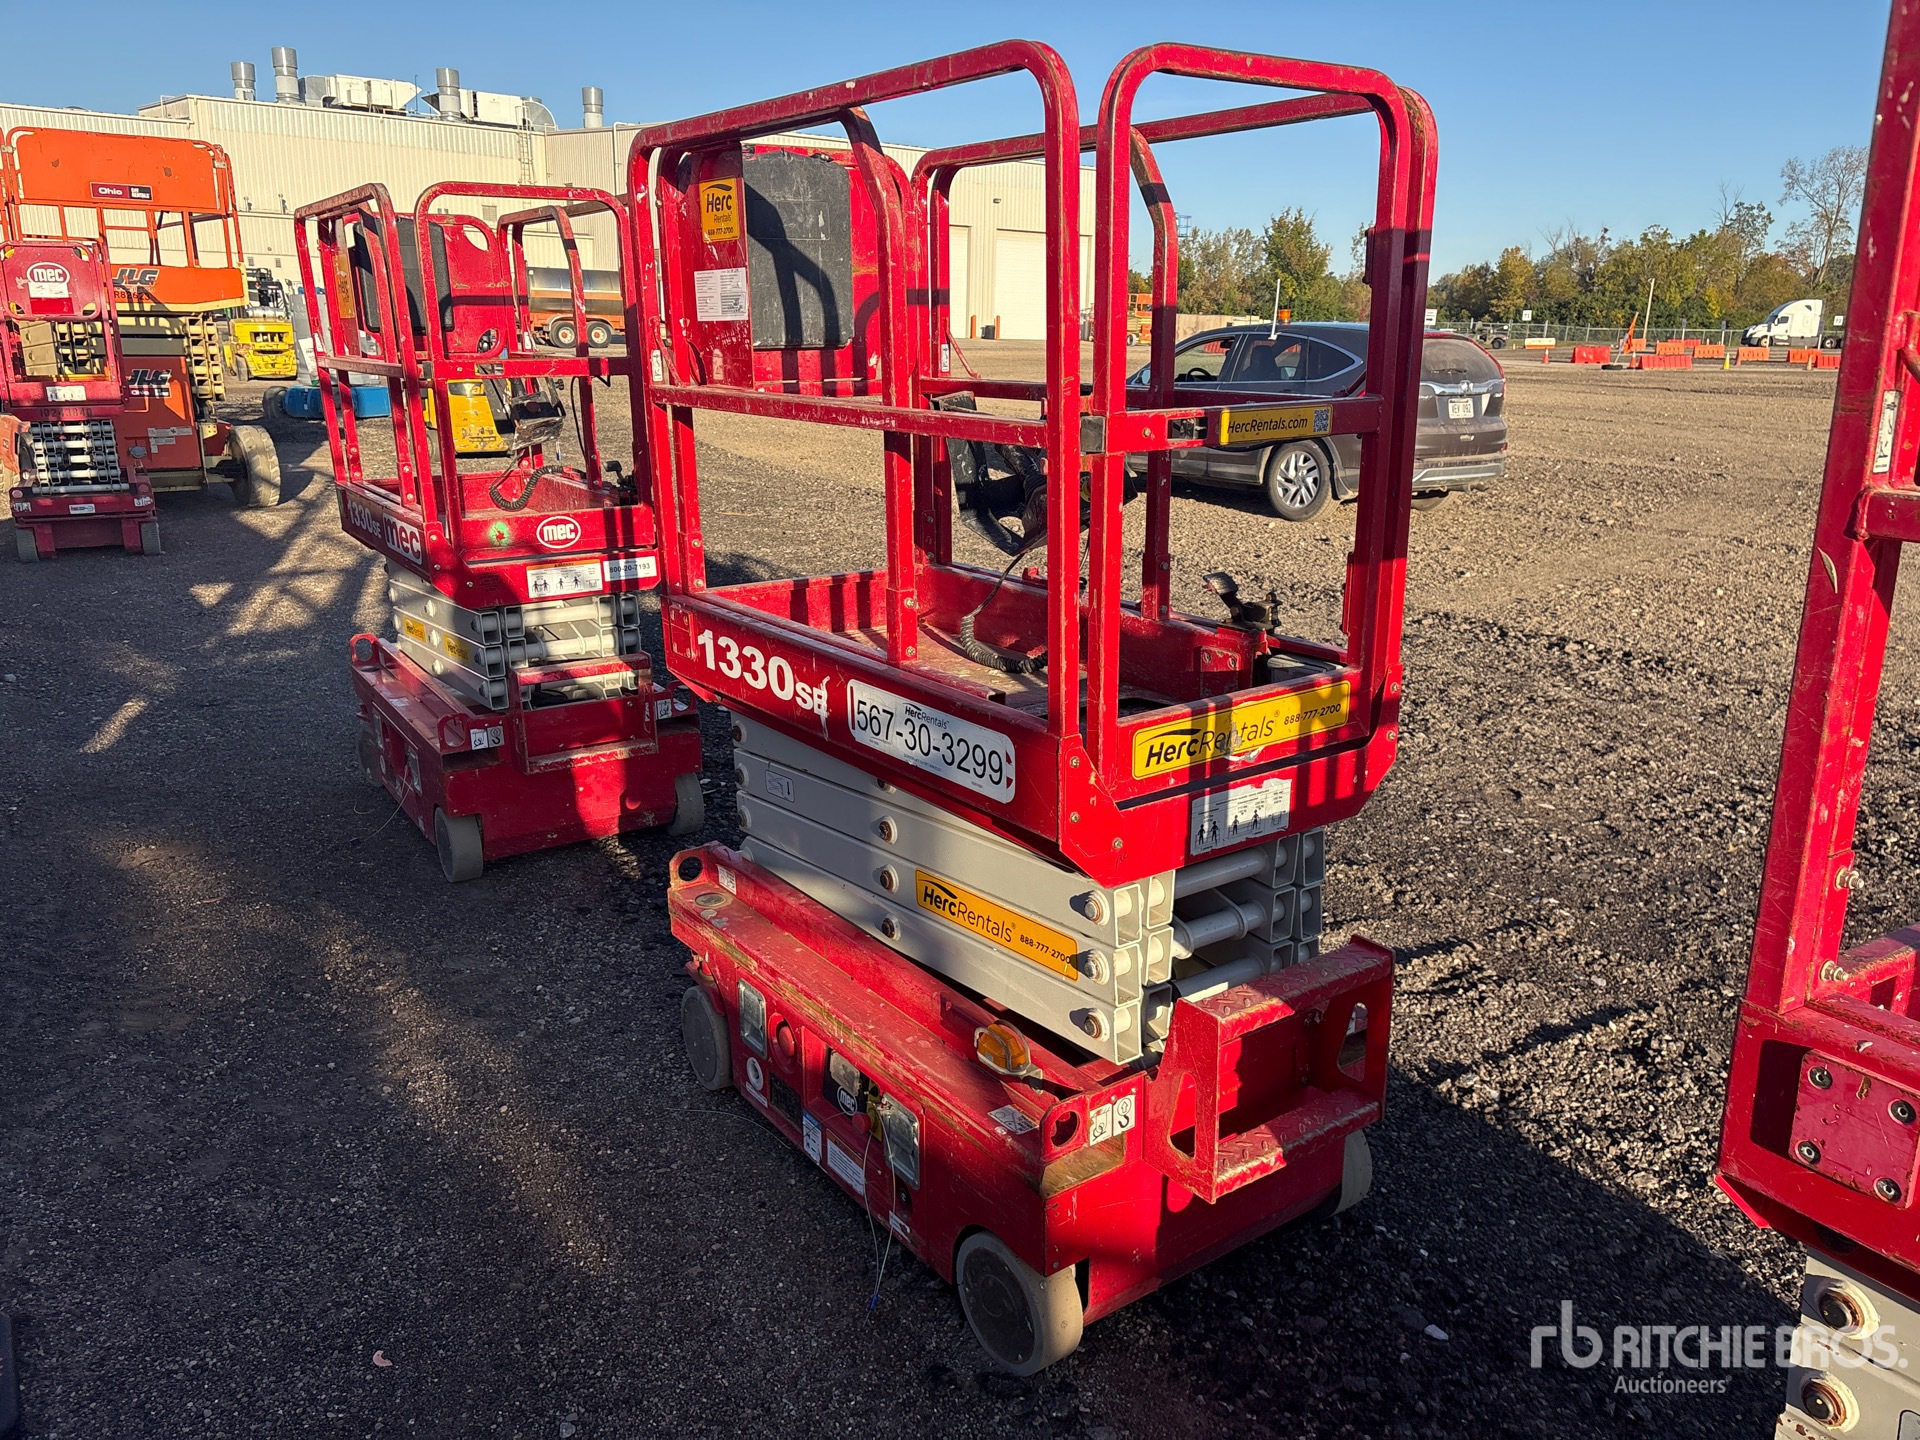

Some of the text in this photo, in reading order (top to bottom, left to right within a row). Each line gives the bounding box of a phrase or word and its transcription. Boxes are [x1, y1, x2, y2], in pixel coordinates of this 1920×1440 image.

[98, 187, 123, 195] Ohio
[706, 193, 732, 213] Herc
[713, 213, 732, 224] Rentals
[112, 268, 159, 286] JLG
[128, 369, 172, 386] JLG
[1226, 417, 1308, 434] HercRentals.com
[609, 562, 651, 573] 800-20-7193
[904, 705, 949, 730] HercRentals
[1283, 702, 1342, 726] 888-777-2700
[856, 699, 1004, 786] 567-30-3299
[923, 885, 1071, 965] HercRentals 888-777-2700
